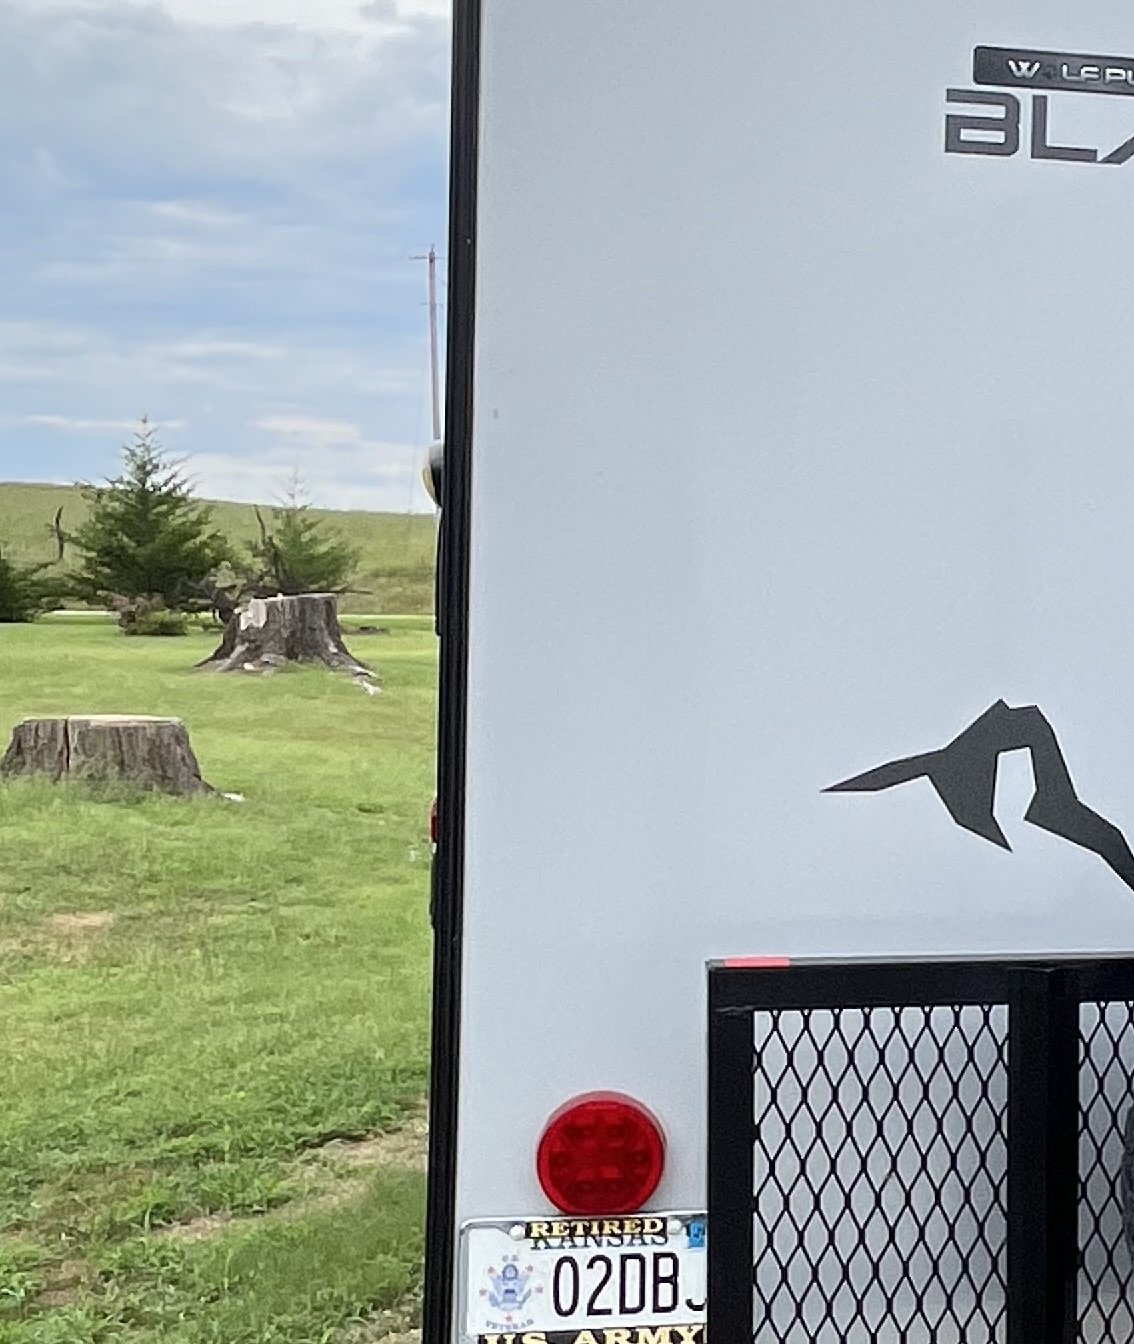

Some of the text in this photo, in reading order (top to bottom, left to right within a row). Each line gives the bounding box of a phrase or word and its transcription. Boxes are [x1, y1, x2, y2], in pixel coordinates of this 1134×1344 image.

[1008, 60, 1100, 82] WLF
[530, 1218, 664, 1238] RETIRED
[552, 1252, 707, 1317] 02DB
